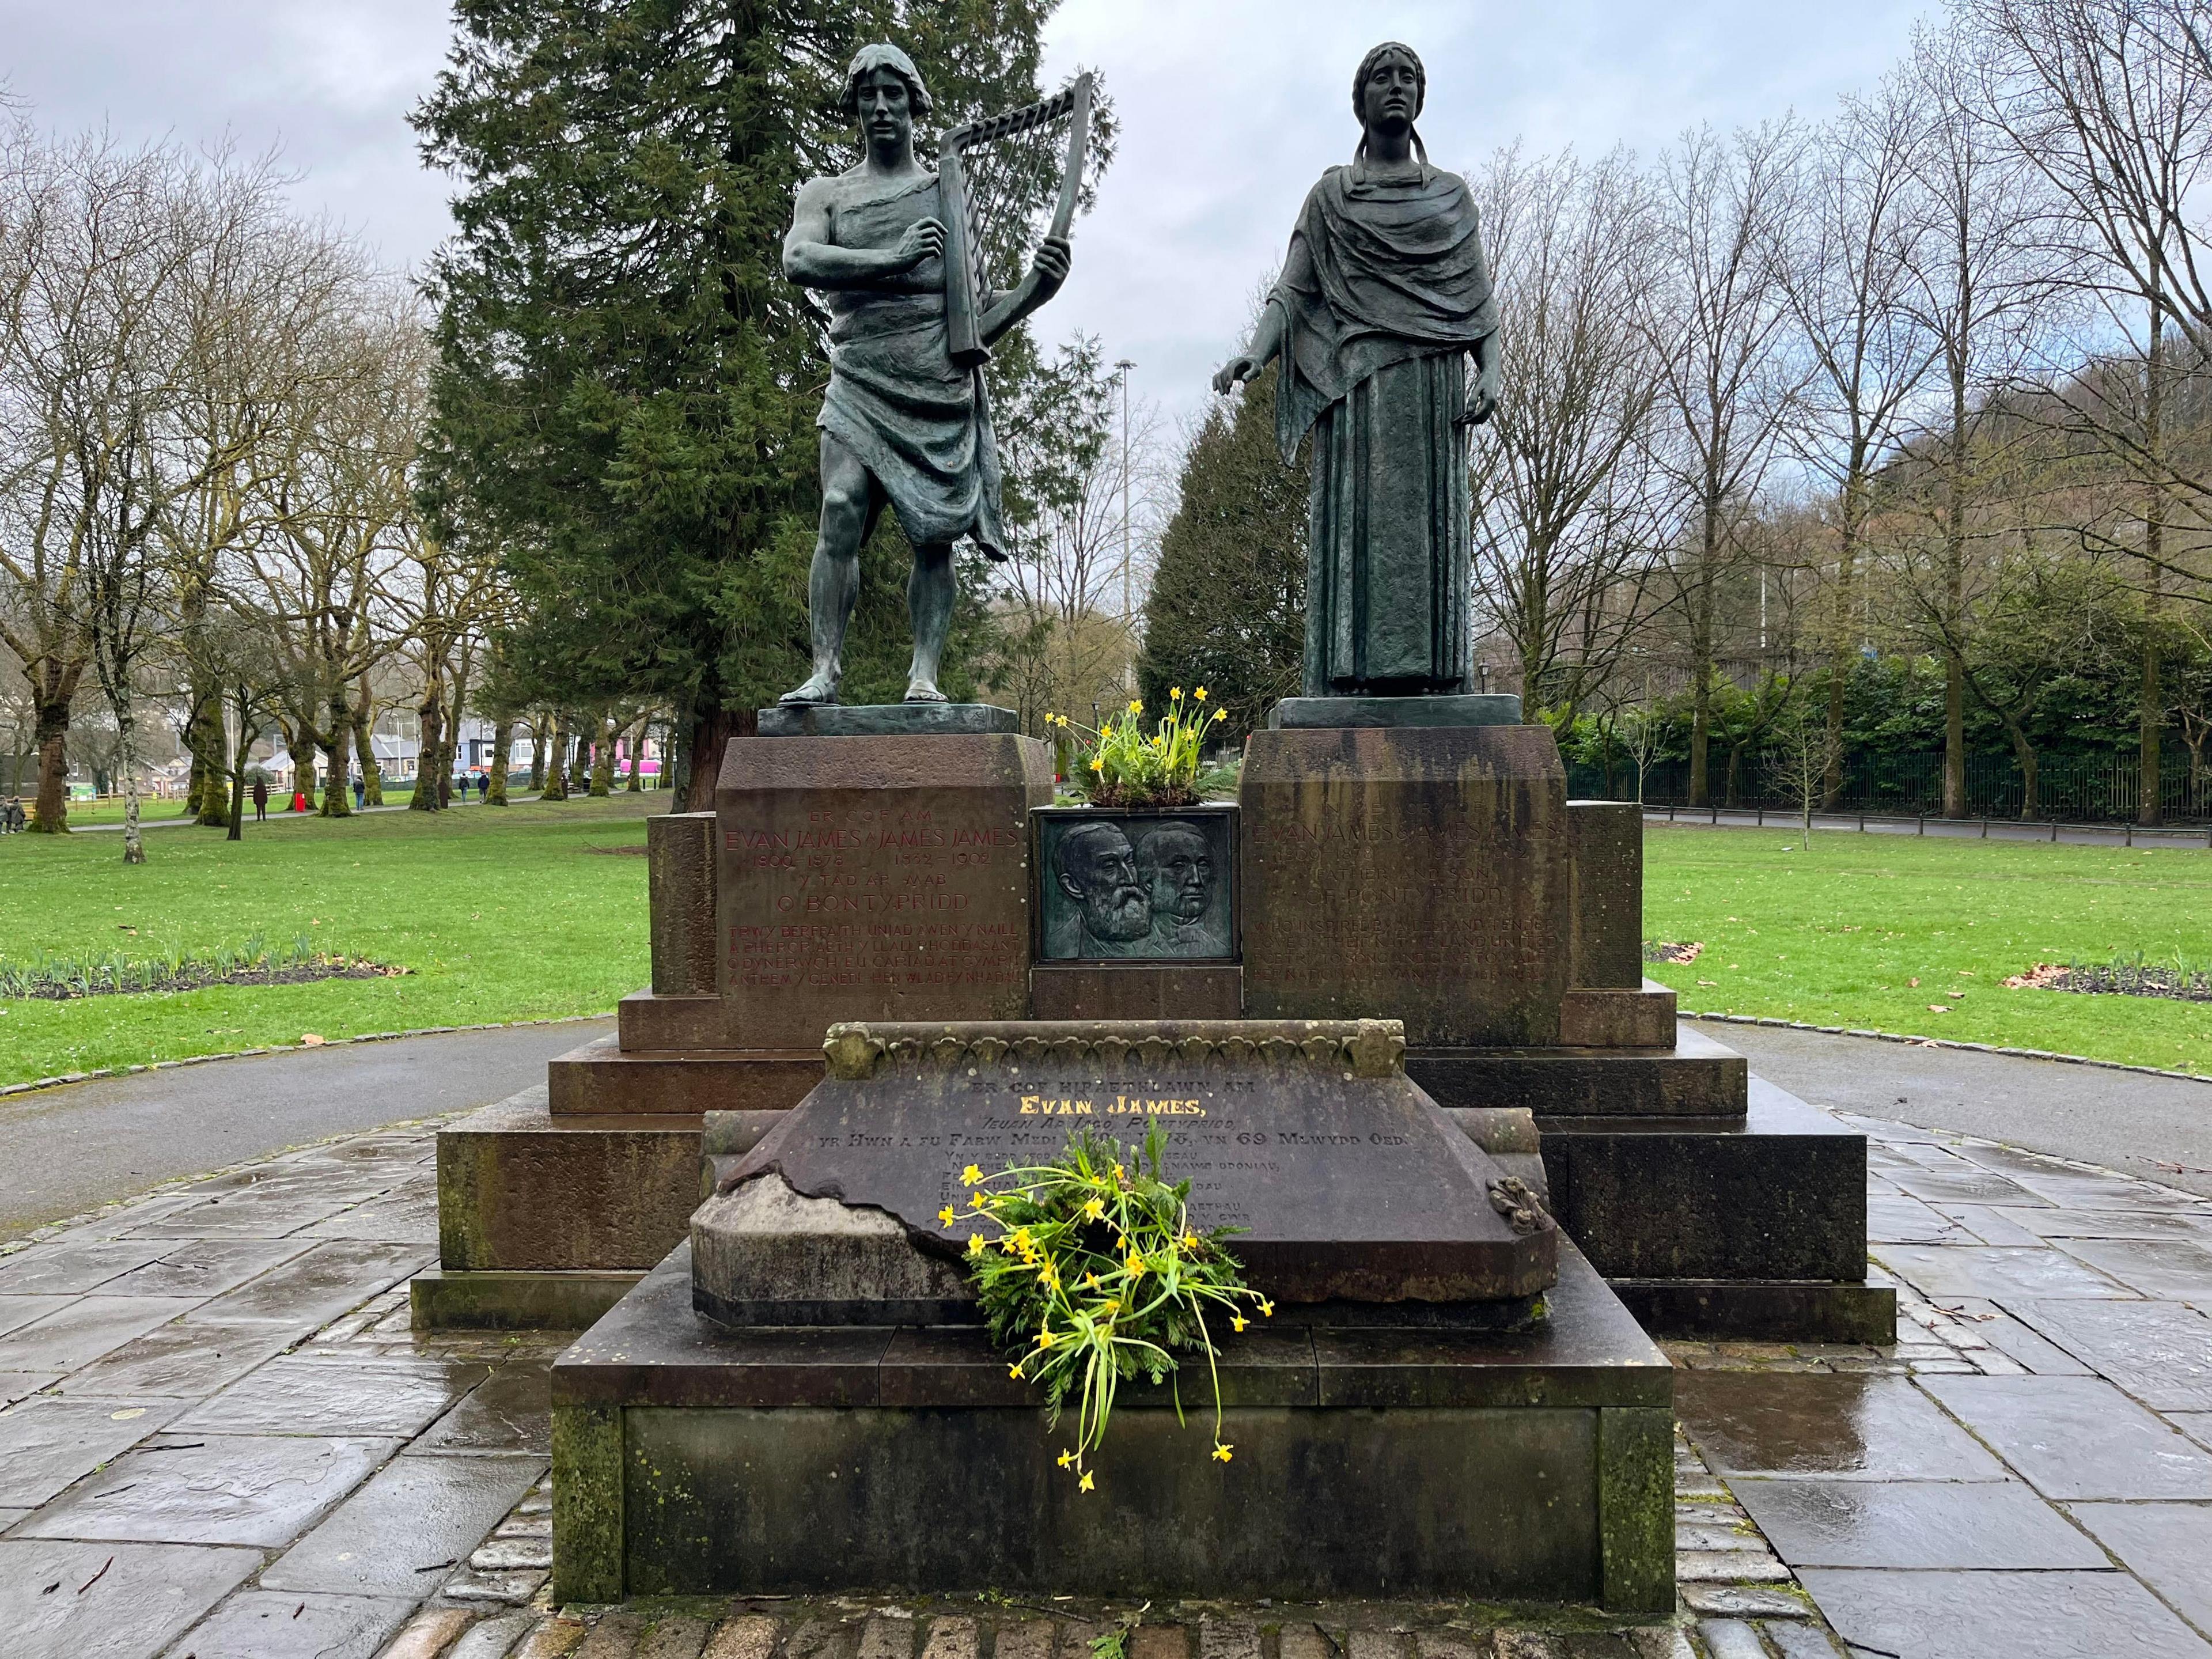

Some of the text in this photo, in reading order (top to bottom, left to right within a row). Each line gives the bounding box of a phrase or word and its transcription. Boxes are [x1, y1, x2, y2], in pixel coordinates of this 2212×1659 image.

[810, 809, 932, 823] ER COF AM
[725, 830, 789, 851] EVAN
[790, 829, 862, 852] JAMES
[873, 828, 945, 852] JAMES
[949, 828, 1019, 850] JAMES
[1253, 823, 1318, 843] EVAN
[1320, 822, 1393, 846] JAMES
[800, 875, 810, 892] Y
[819, 874, 857, 888] TAD
[906, 873, 947, 887] MAB
[1317, 867, 1490, 881] FATHER AND SON
[778, 893, 968, 914] O BONTYPRIDD
[1305, 887, 1502, 906] OF PONTYPRIDD
[728, 926, 777, 940] TRWY
[868, 923, 913, 938] UNIAD
[917, 923, 958, 937] AWEN
[978, 922, 1018, 937] NAILL
[729, 942, 739, 955] A
[857, 941, 868, 956] Y
[873, 940, 915, 953] LLALL
[845, 956, 867, 970] EU
[873, 956, 935, 969] CARIAD
[938, 956, 958, 968] AT
[728, 973, 792, 987] ANTHEM
[795, 972, 806, 987] Y
[904, 971, 944, 986] WLAD
[971, 1081, 998, 1093] ER
[1009, 1081, 1048, 1093] COF
[1223, 1081, 1256, 1093] AM
[1018, 1094, 1207, 1118] EVAN JAMES,
[1235, 1132, 1267, 1145] 69
